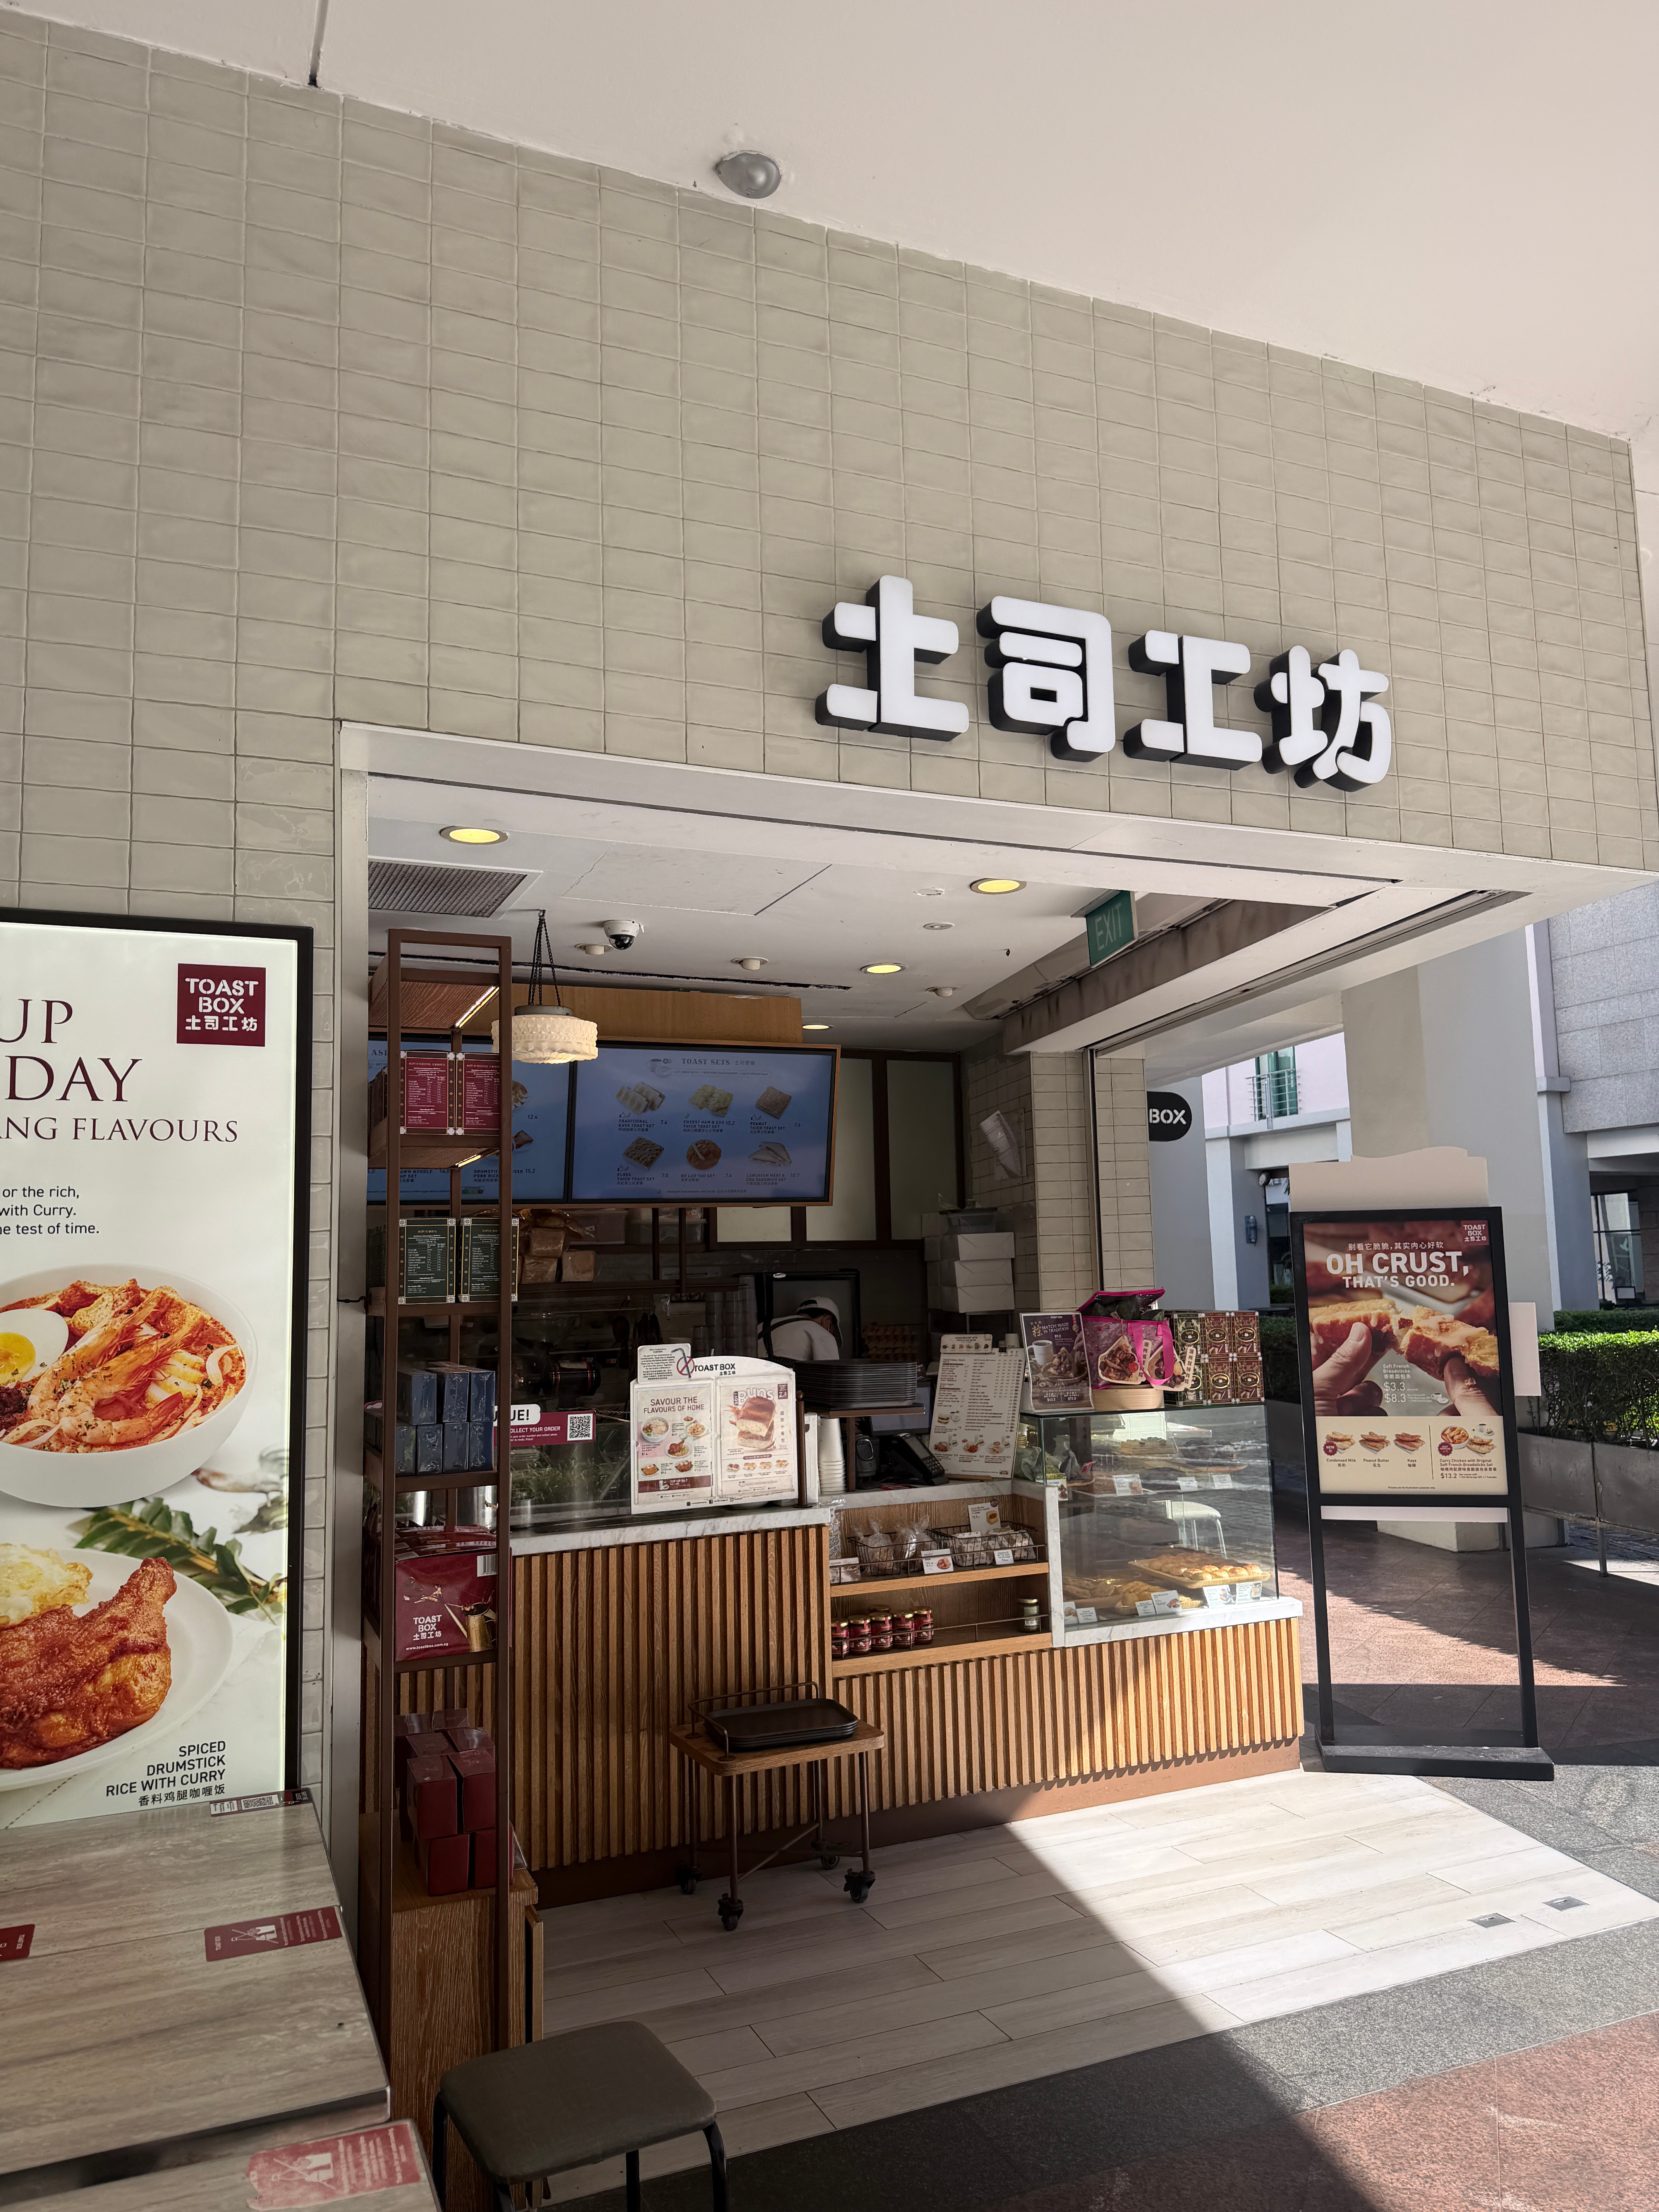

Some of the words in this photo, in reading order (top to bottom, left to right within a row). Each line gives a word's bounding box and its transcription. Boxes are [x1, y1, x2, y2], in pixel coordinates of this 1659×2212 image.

[816, 575, 1391, 791] 土司工坊
[1095, 902, 1122, 951] EXIT
[185, 978, 258, 996] TOAST
[198, 997, 244, 1013] BOX
[185, 1016, 257, 1032] 土司工坊
[5, 1055, 142, 1102] DAY
[1149, 1108, 1187, 1125] BOX
[0, 1117, 57, 1140] NG
[73, 1118, 237, 1142] FLAVOURS
[2, 1188, 18, 1198] or
[22, 1186, 44, 1197] the
[50, 1186, 79, 1199] rich,
[33, 1204, 76, 1218] Curry.
[16, 1224, 43, 1234] test
[47, 1223, 60, 1234] of
[65, 1222, 99, 1233] time.
[1326, 1253, 1363, 1274] OH
[1372, 1251, 1469, 1276] CRUST,
[1342, 1276, 1399, 1288] THAT'S
[1405, 1275, 1455, 1287] GOOD.
[1384, 1382, 1405, 1392] $3.3
[651, 1397, 682, 1406] SAVOUR
[1384, 1393, 1406, 1403] $8.3
[644, 1406, 676, 1414] FLAVOURS
[413, 1614, 442, 1625] TOAST
[418, 1623, 436, 1632] BOX
[413, 1631, 442, 1641] 土司工坊
[406, 1642, 448, 1650] www.toastbox.com.sg
[179, 1741, 226, 1757] SPICED
[147, 1755, 225, 1776] DRUMSTICK
[106, 1782, 136, 1797] RICE
[141, 1776, 176, 1793] WITH
[180, 1768, 225, 1786] CURRY
[139, 1783, 225, 1807] 香料鸡腿咖喱饭
